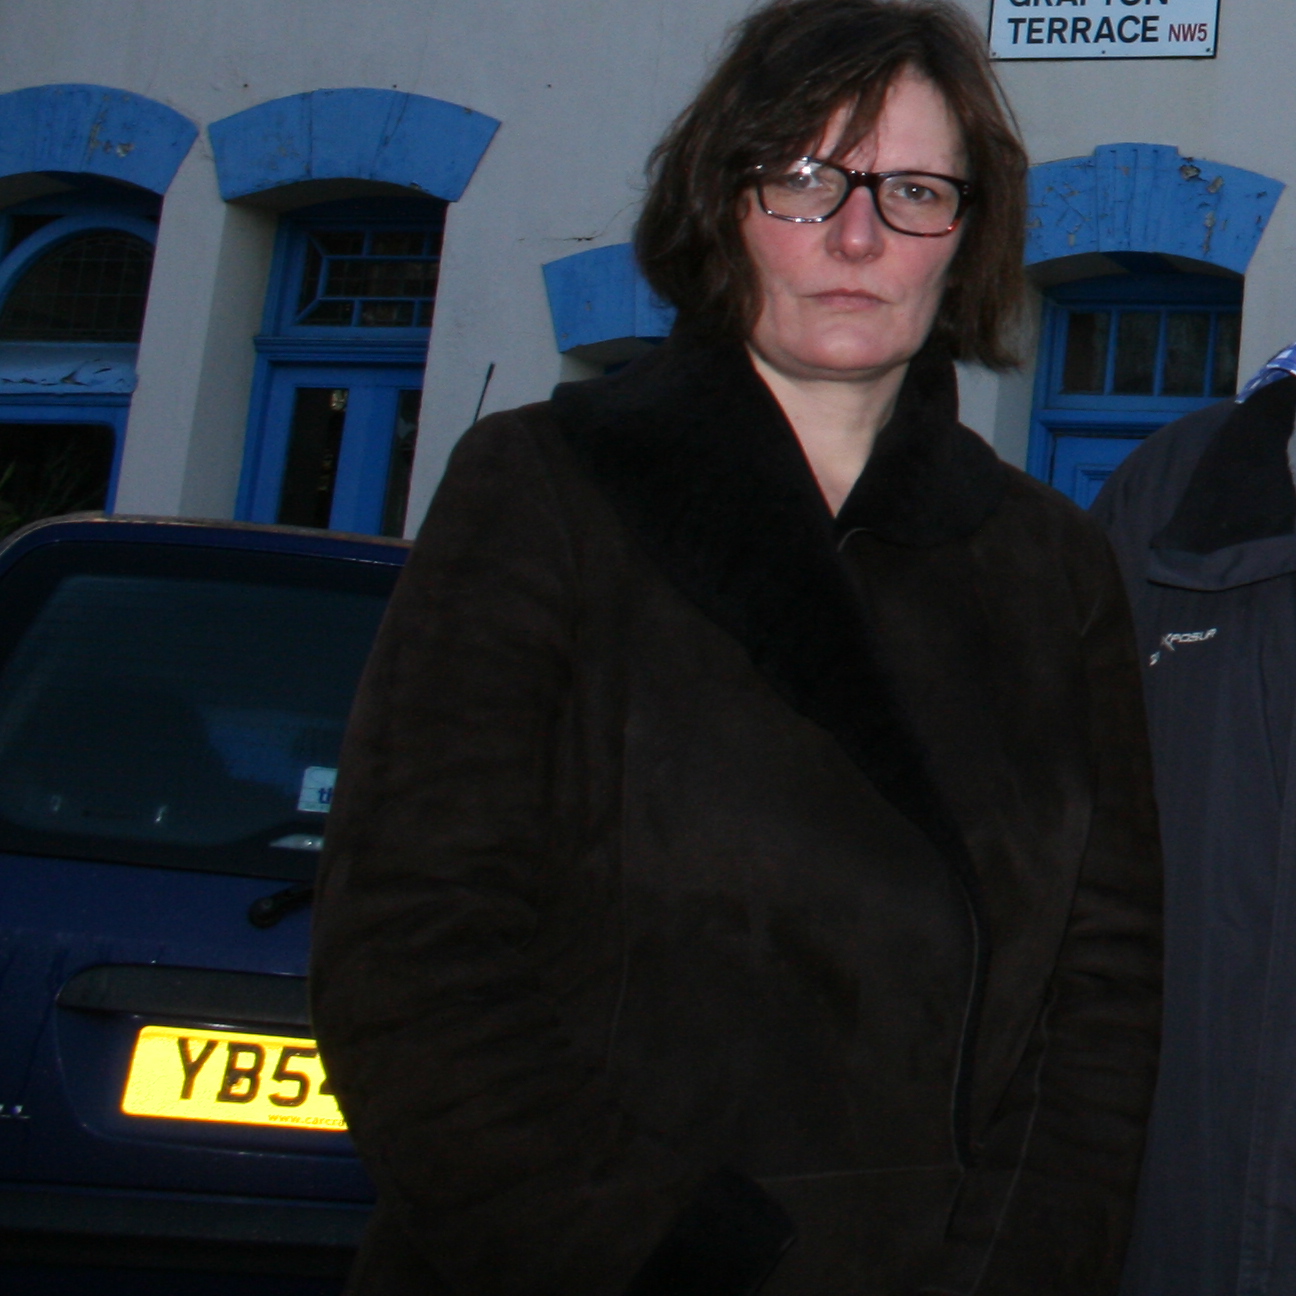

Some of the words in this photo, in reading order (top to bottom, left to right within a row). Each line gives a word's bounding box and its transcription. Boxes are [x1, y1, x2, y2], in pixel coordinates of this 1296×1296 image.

[1007, 15, 1160, 45] TERRACE
[1168, 23, 1208, 43] NW5
[177, 1037, 336, 1108] YB5
